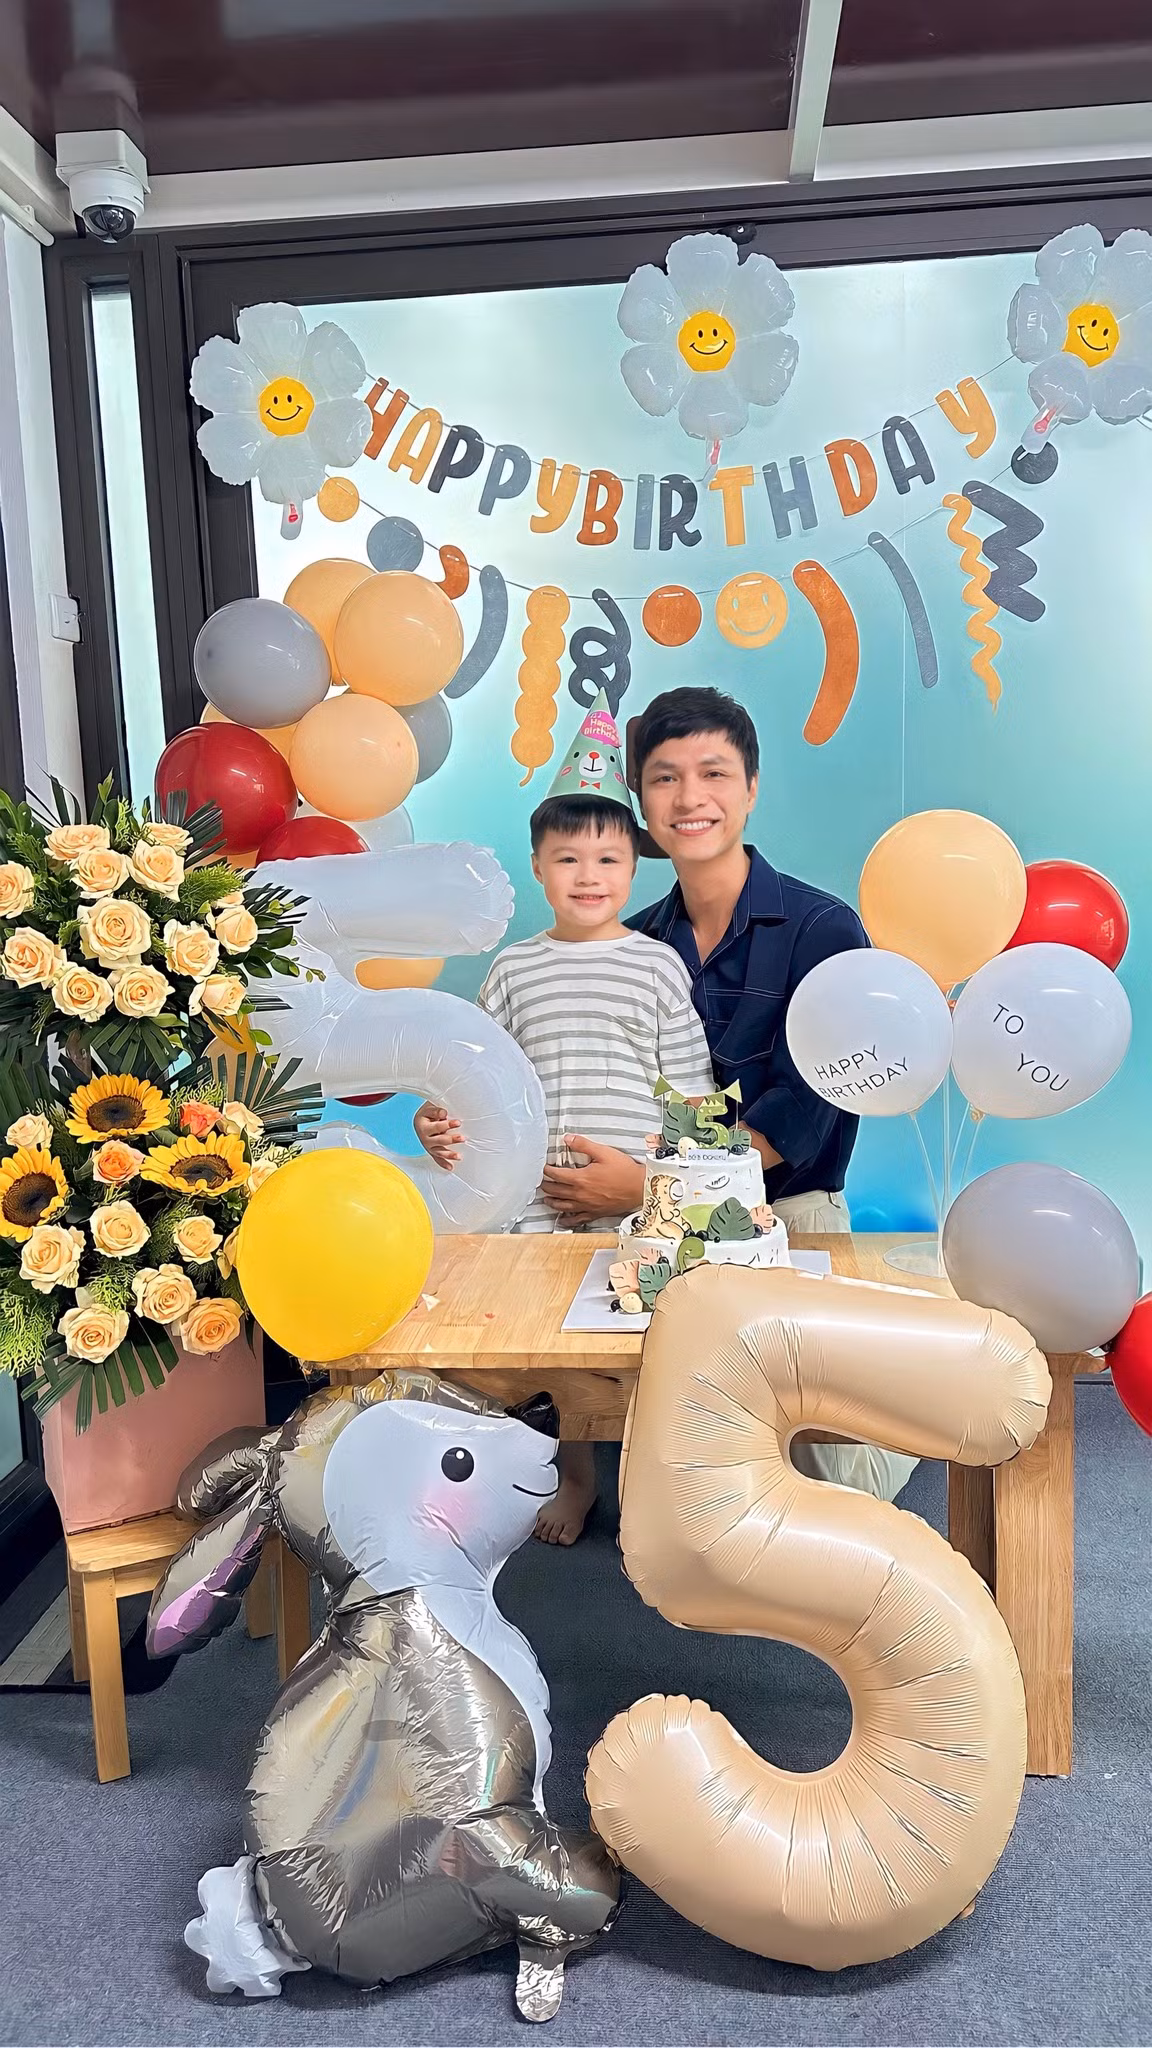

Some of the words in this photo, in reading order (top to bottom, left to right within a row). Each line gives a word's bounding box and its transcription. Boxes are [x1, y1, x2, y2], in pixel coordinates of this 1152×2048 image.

[993, 1003, 1025, 1035] TO
[814, 1045, 879, 1080] HAPPY
[818, 1056, 909, 1099] BIRTHDAY
[1016, 1052, 1070, 1092] YOU
[696, 1100, 730, 1149] 5
[585, 1263, 1053, 1972] 5
